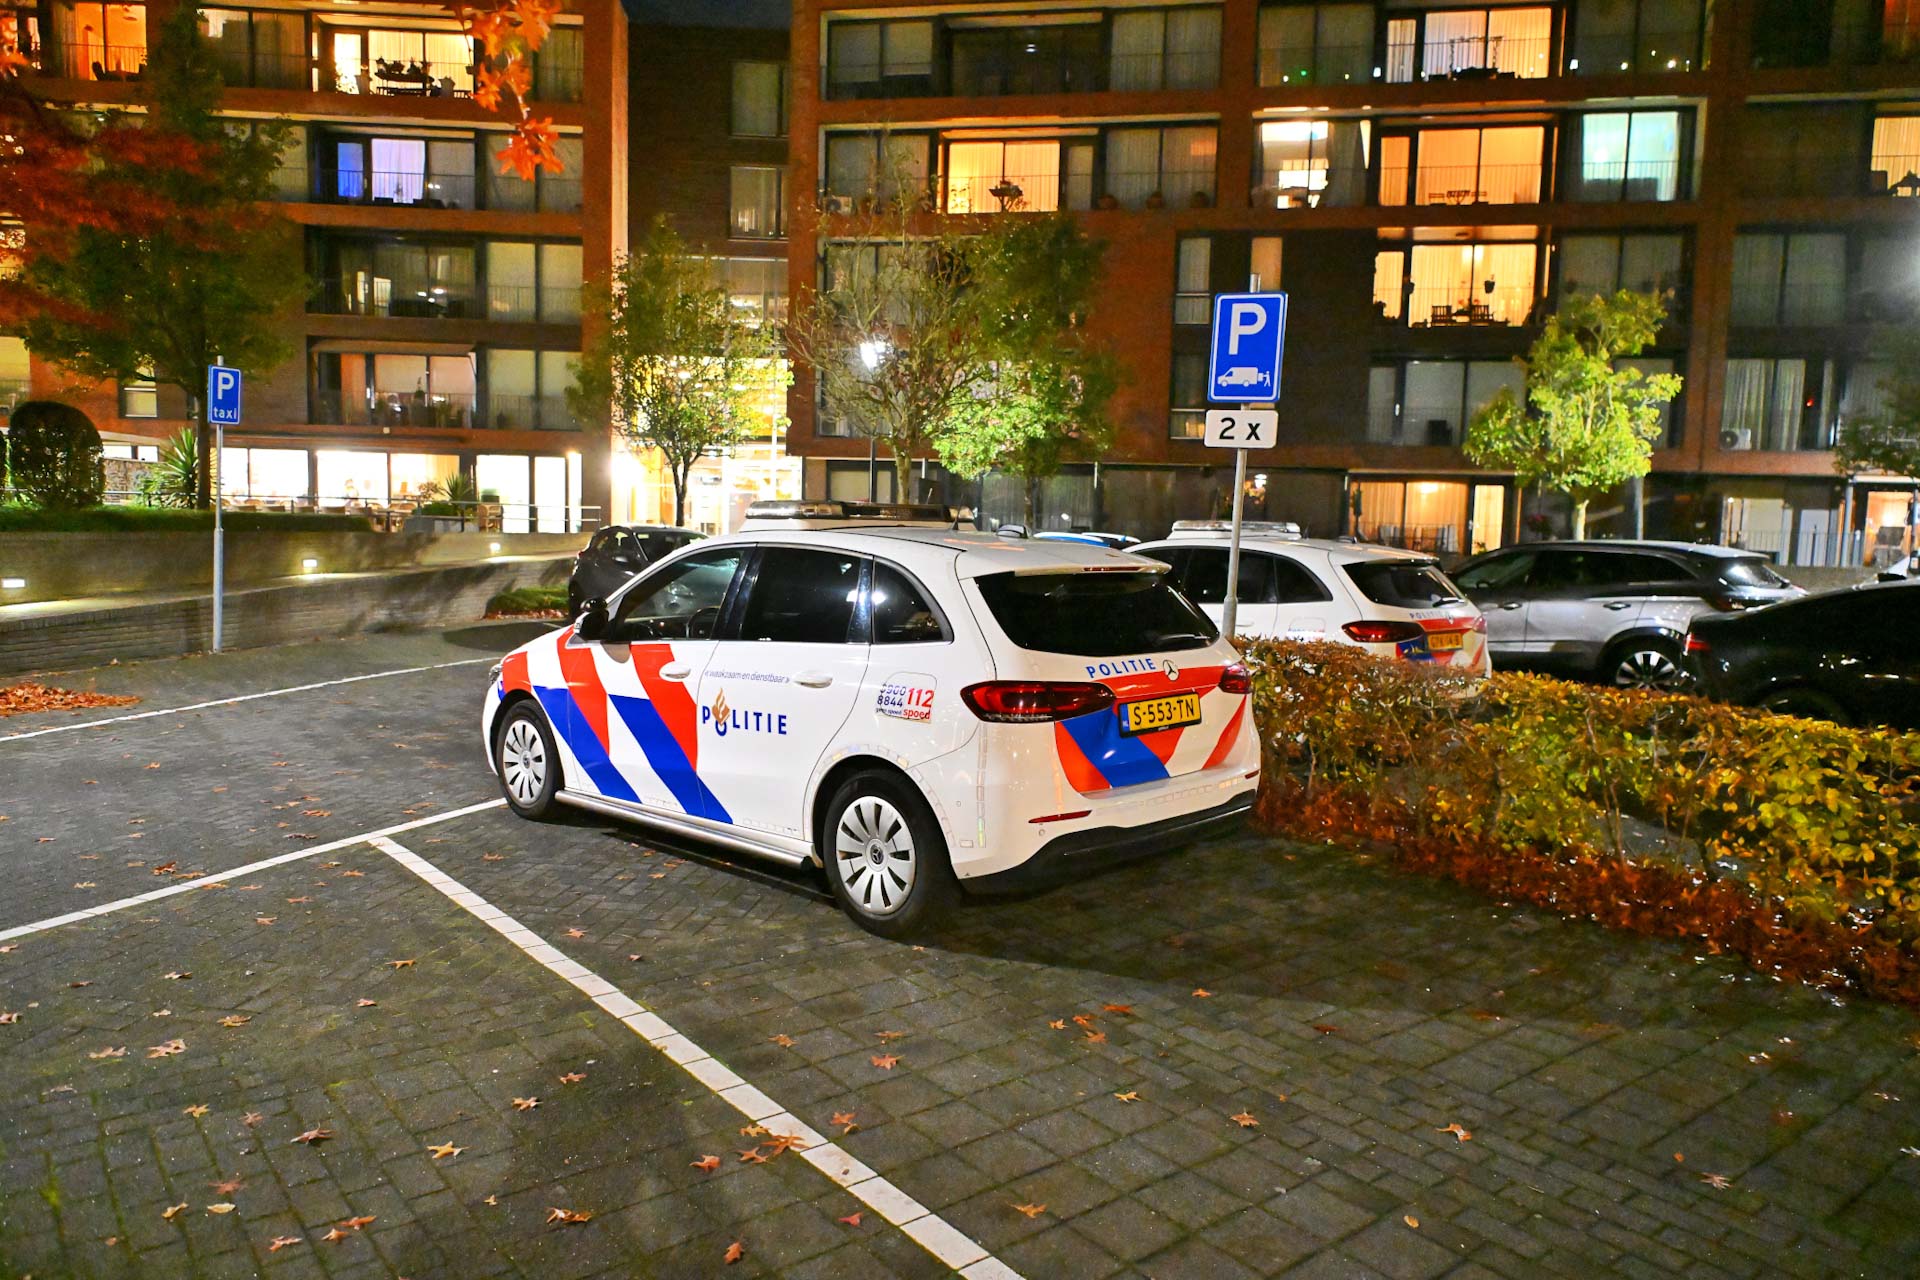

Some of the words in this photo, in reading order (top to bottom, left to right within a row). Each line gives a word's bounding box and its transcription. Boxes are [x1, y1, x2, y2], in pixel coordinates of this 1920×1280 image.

[1228, 303, 1267, 355] P
[217, 371, 235, 400] P
[213, 406, 237, 420] taxi
[1219, 417, 1236, 440] 2
[1085, 658, 1156, 679] POLITIE
[880, 683, 907, 696] 0900
[907, 687, 935, 708] 112
[877, 695, 903, 707] 8844
[702, 704, 787, 737] POLITIE
[903, 708, 931, 720] spoed
[1133, 698, 1195, 726] S-553-TN
